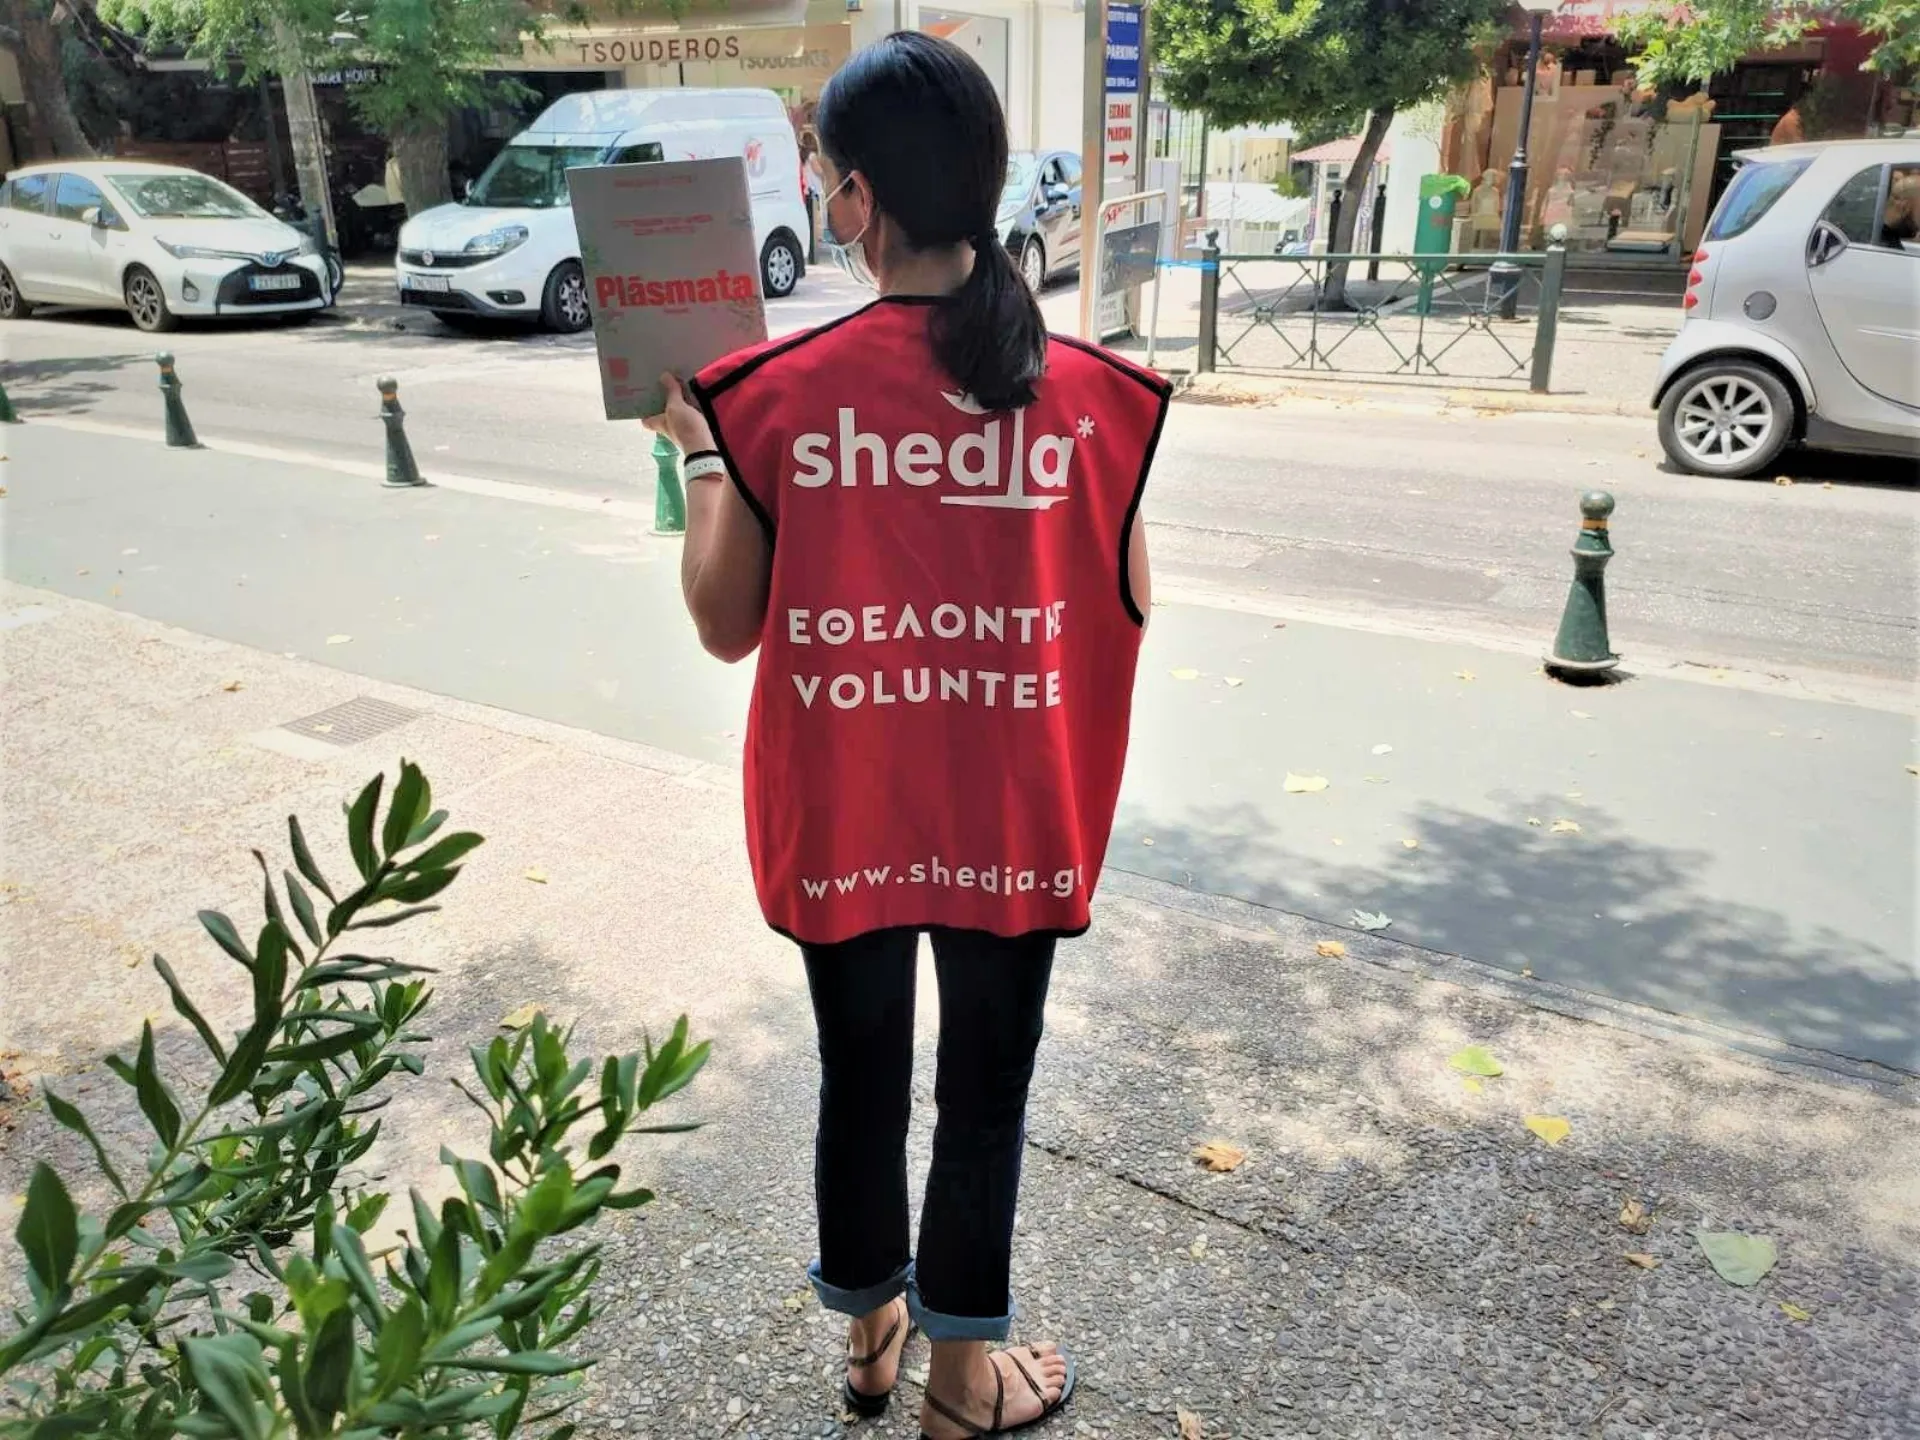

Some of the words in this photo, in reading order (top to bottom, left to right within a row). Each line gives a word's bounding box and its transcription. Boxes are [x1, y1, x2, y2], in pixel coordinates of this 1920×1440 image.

[580, 36, 740, 63] TSOUDEROS
[1106, 45, 1138, 60] PARKING
[792, 667, 1063, 710] VOLUNTEE
